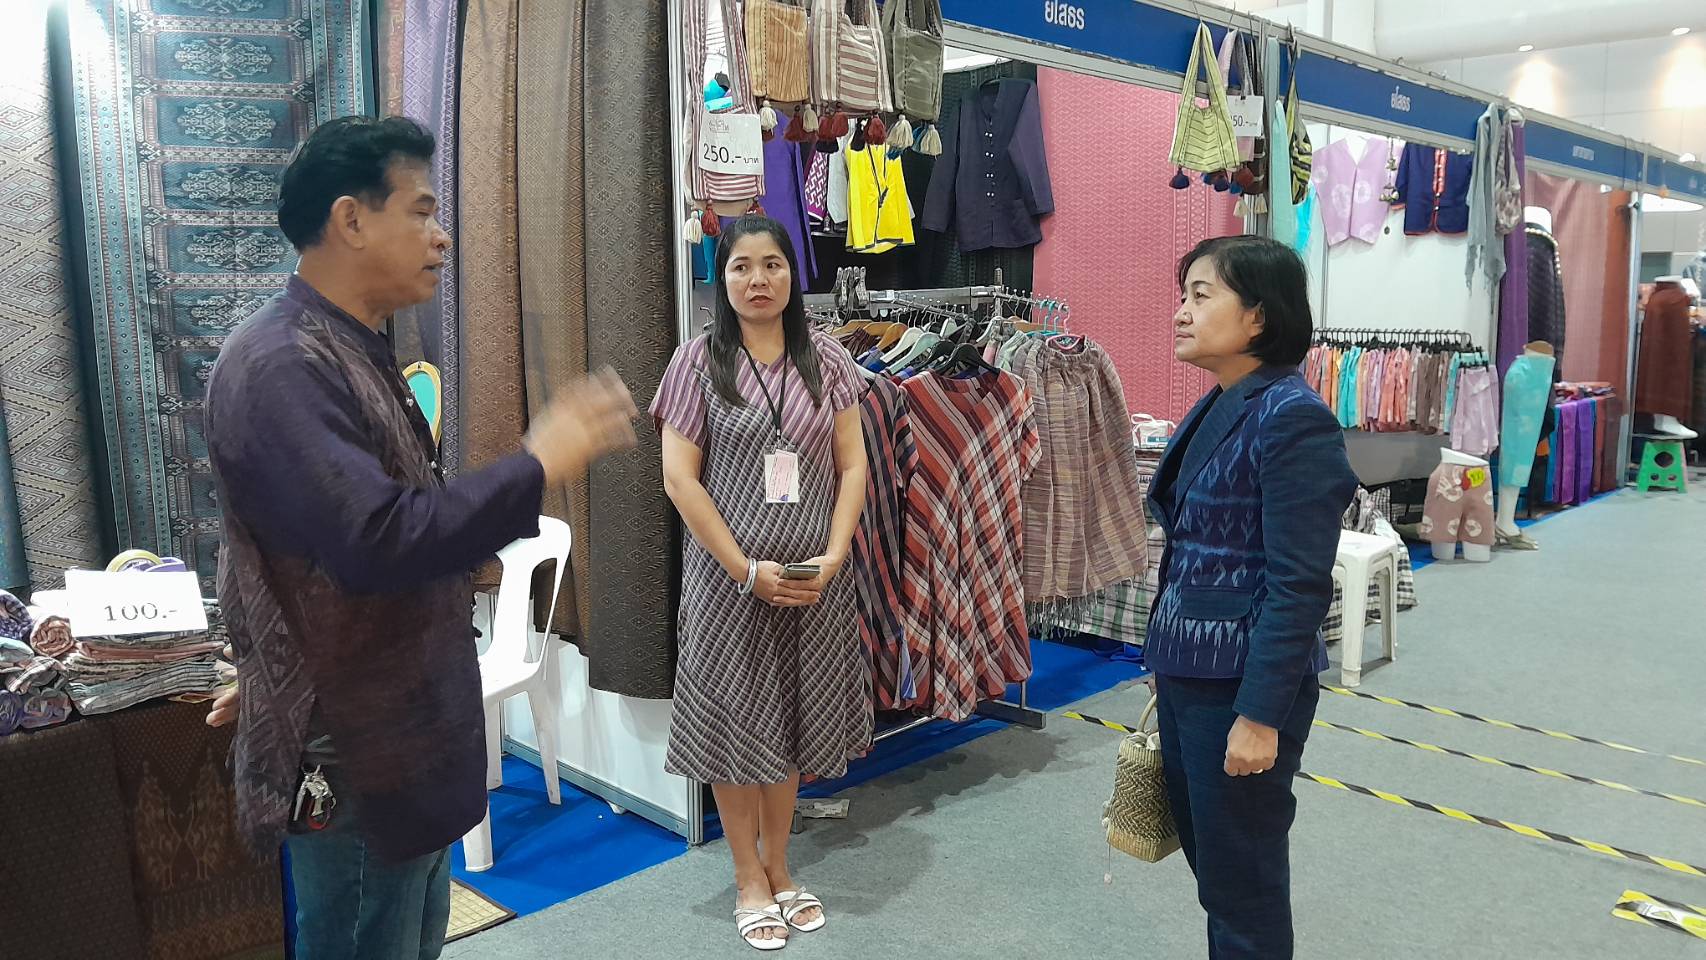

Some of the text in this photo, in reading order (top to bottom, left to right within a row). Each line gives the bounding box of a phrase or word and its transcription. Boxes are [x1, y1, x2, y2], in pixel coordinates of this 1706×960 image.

[1230, 115, 1249, 127] 50.-
[703, 143, 742, 164] 250.-
[104, 602, 177, 621] 100.-
